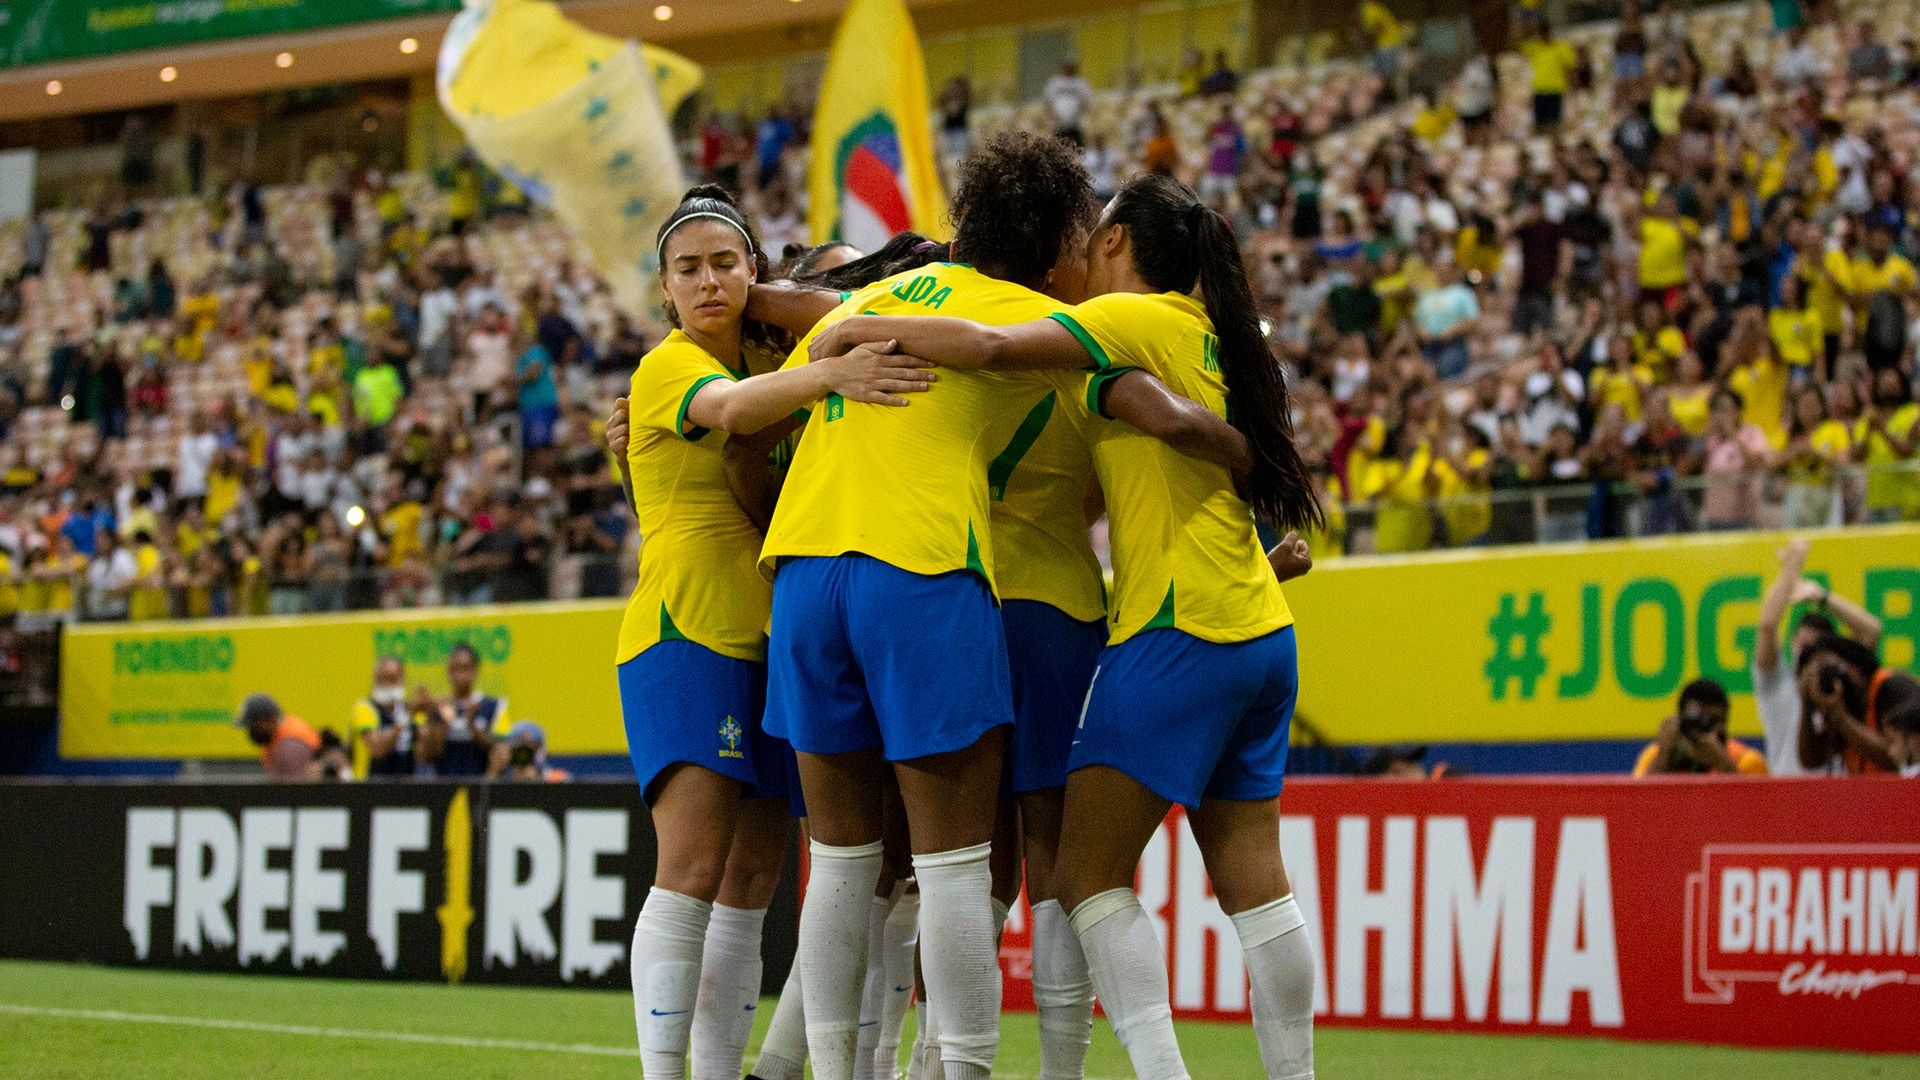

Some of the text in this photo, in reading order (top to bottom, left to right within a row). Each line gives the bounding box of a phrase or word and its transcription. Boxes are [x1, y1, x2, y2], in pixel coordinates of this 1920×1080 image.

[123, 787, 630, 985] FREE FIRE
[1134, 815, 1625, 1028] RHMA
[1720, 867, 1920, 956] BRAHM
